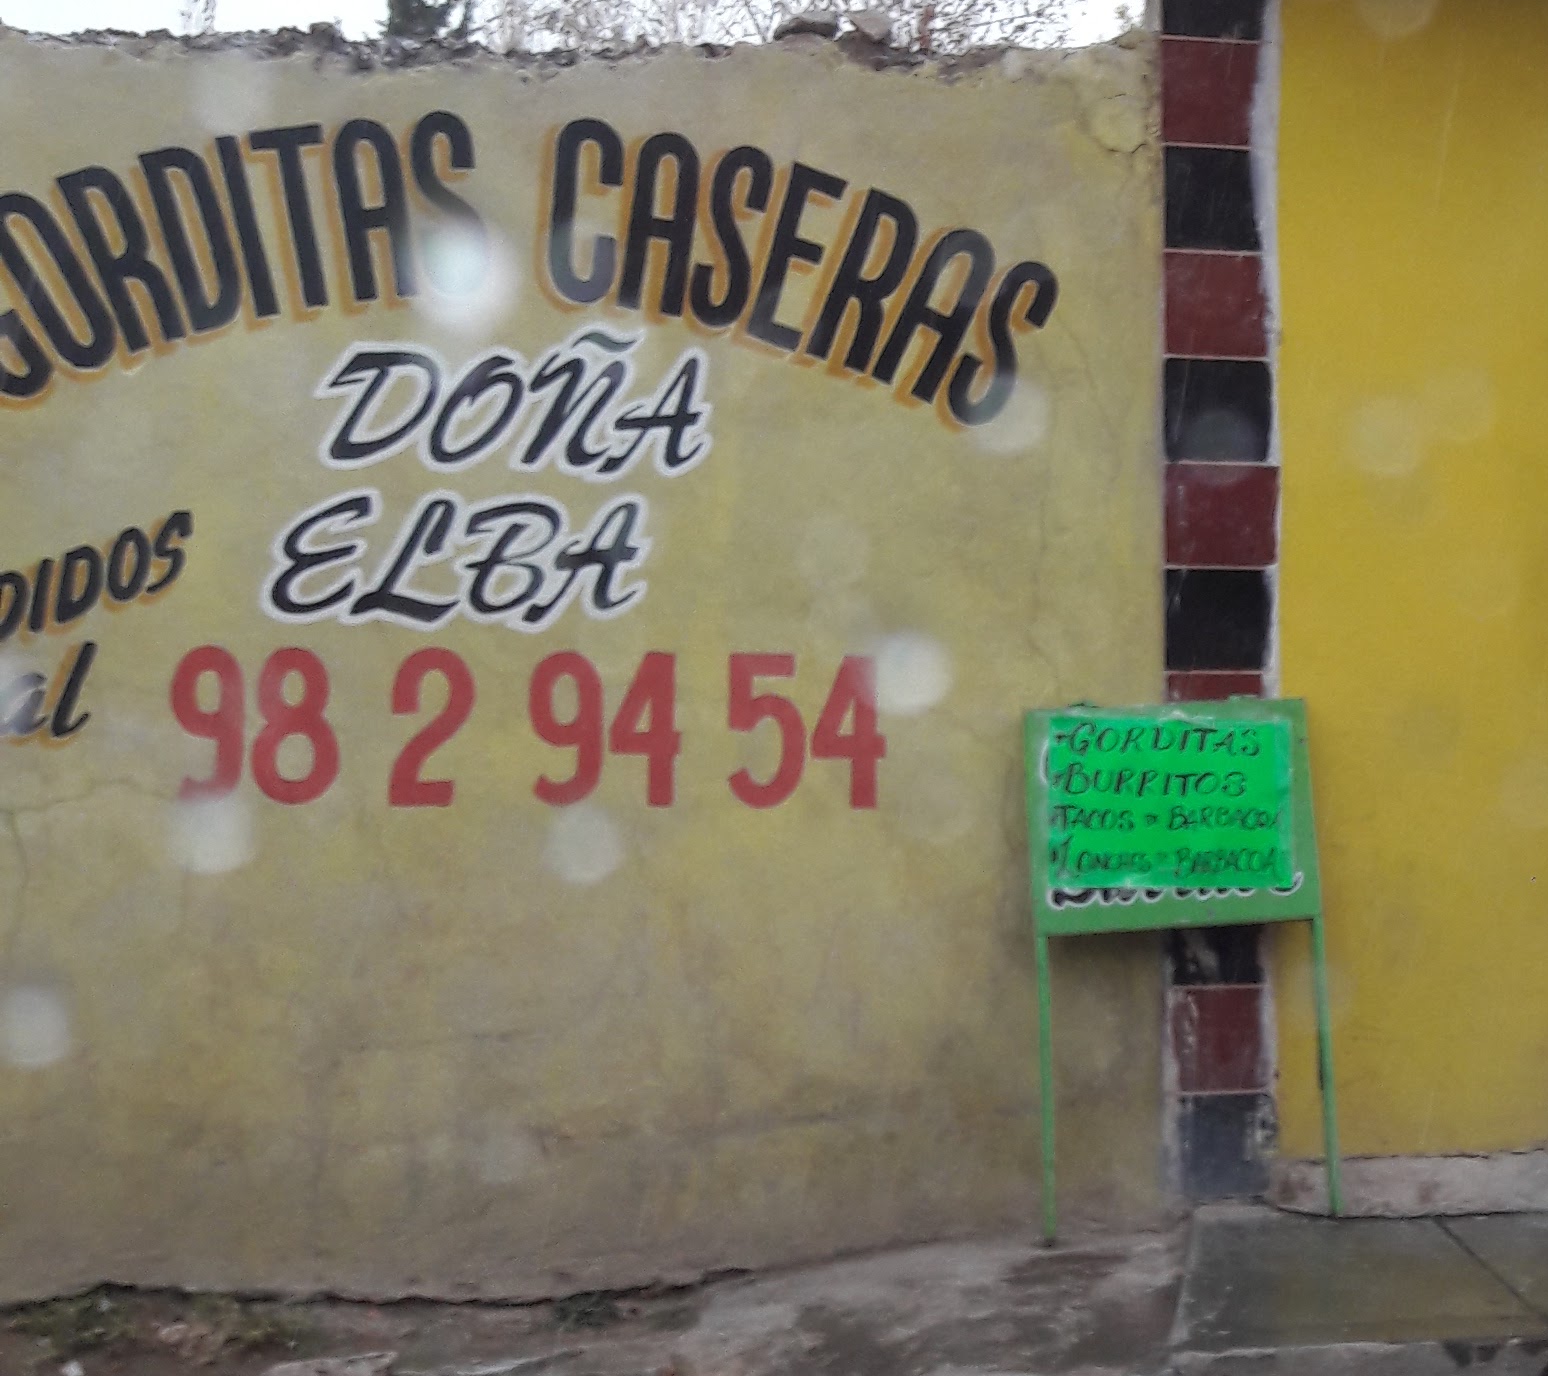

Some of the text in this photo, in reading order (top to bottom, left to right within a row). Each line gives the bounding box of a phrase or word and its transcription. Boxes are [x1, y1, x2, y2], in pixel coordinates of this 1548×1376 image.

[548, 117, 1058, 426] CASERAS
[322, 328, 710, 476] DOÑA
[268, 494, 648, 623] ELBA
[170, 645, 886, 810] 98 2 94 54
